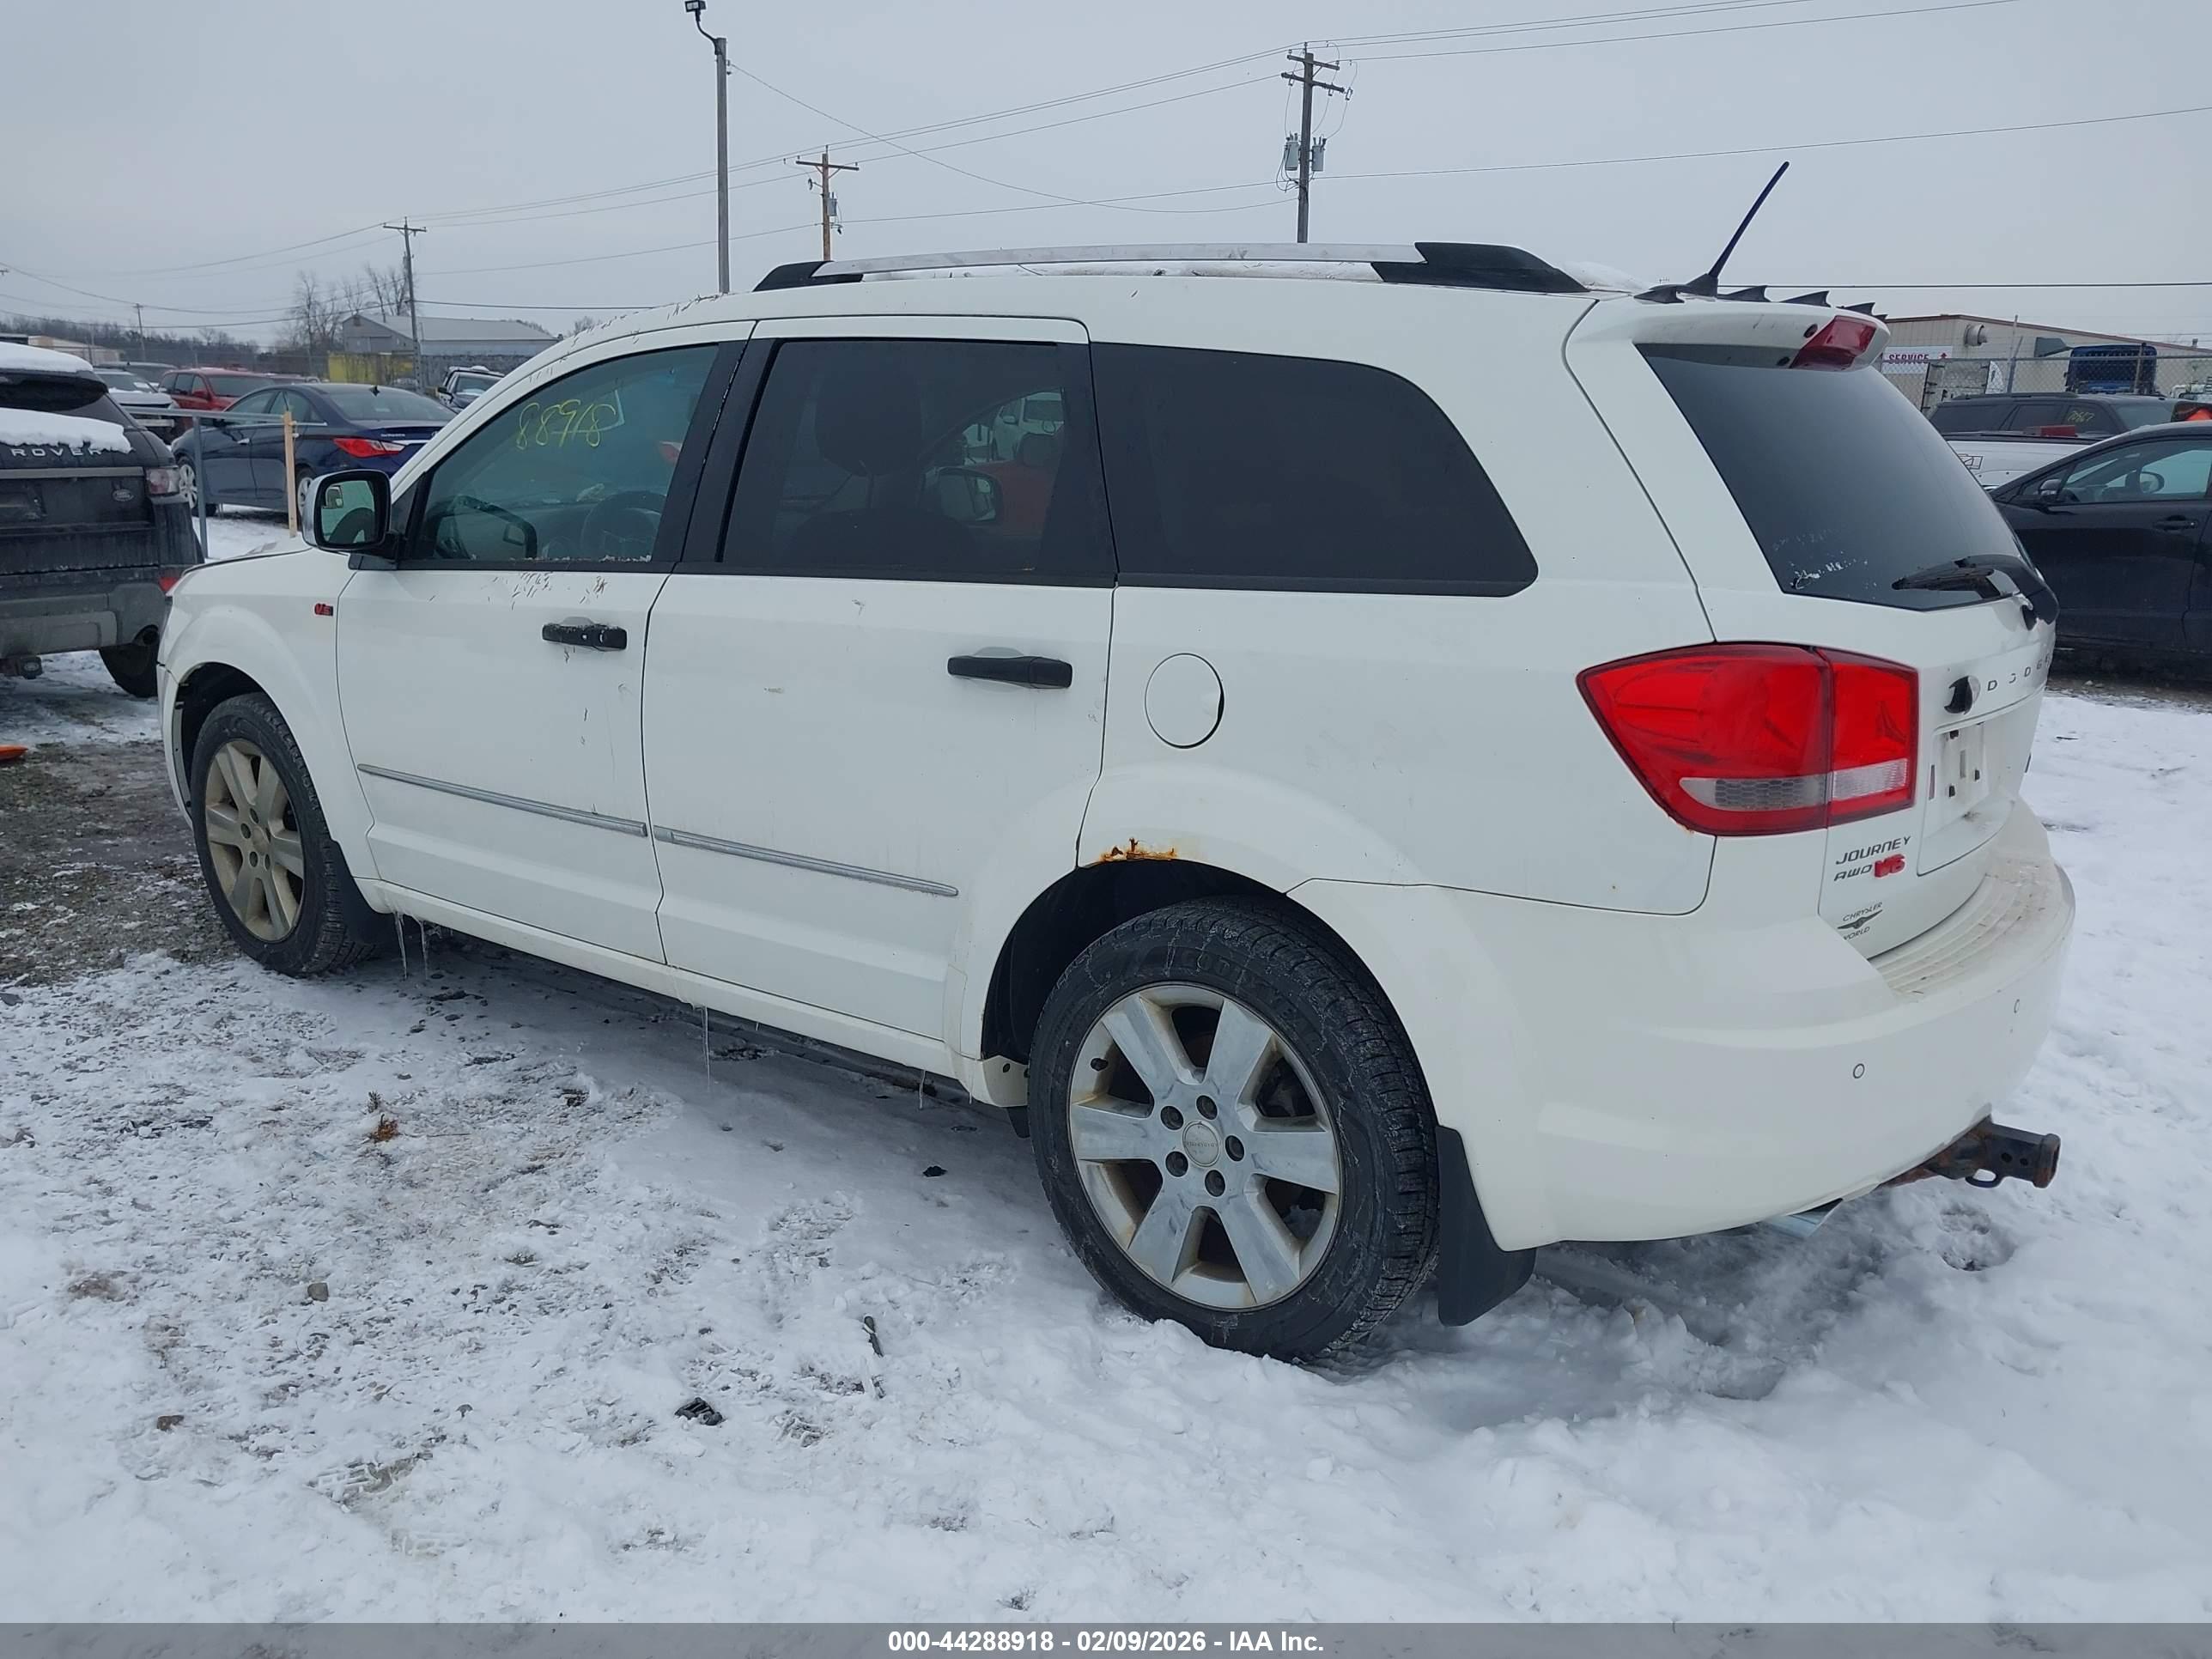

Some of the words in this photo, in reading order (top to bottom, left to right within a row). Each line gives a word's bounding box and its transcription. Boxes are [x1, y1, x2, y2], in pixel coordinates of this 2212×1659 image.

[1888, 354, 1929, 364] SERVICE
[515, 398, 617, 450] 88918
[1835, 836, 1911, 865] JOURNEY
[1833, 864, 1873, 882] AWD
[1843, 902, 1883, 921] CHRYSLER
